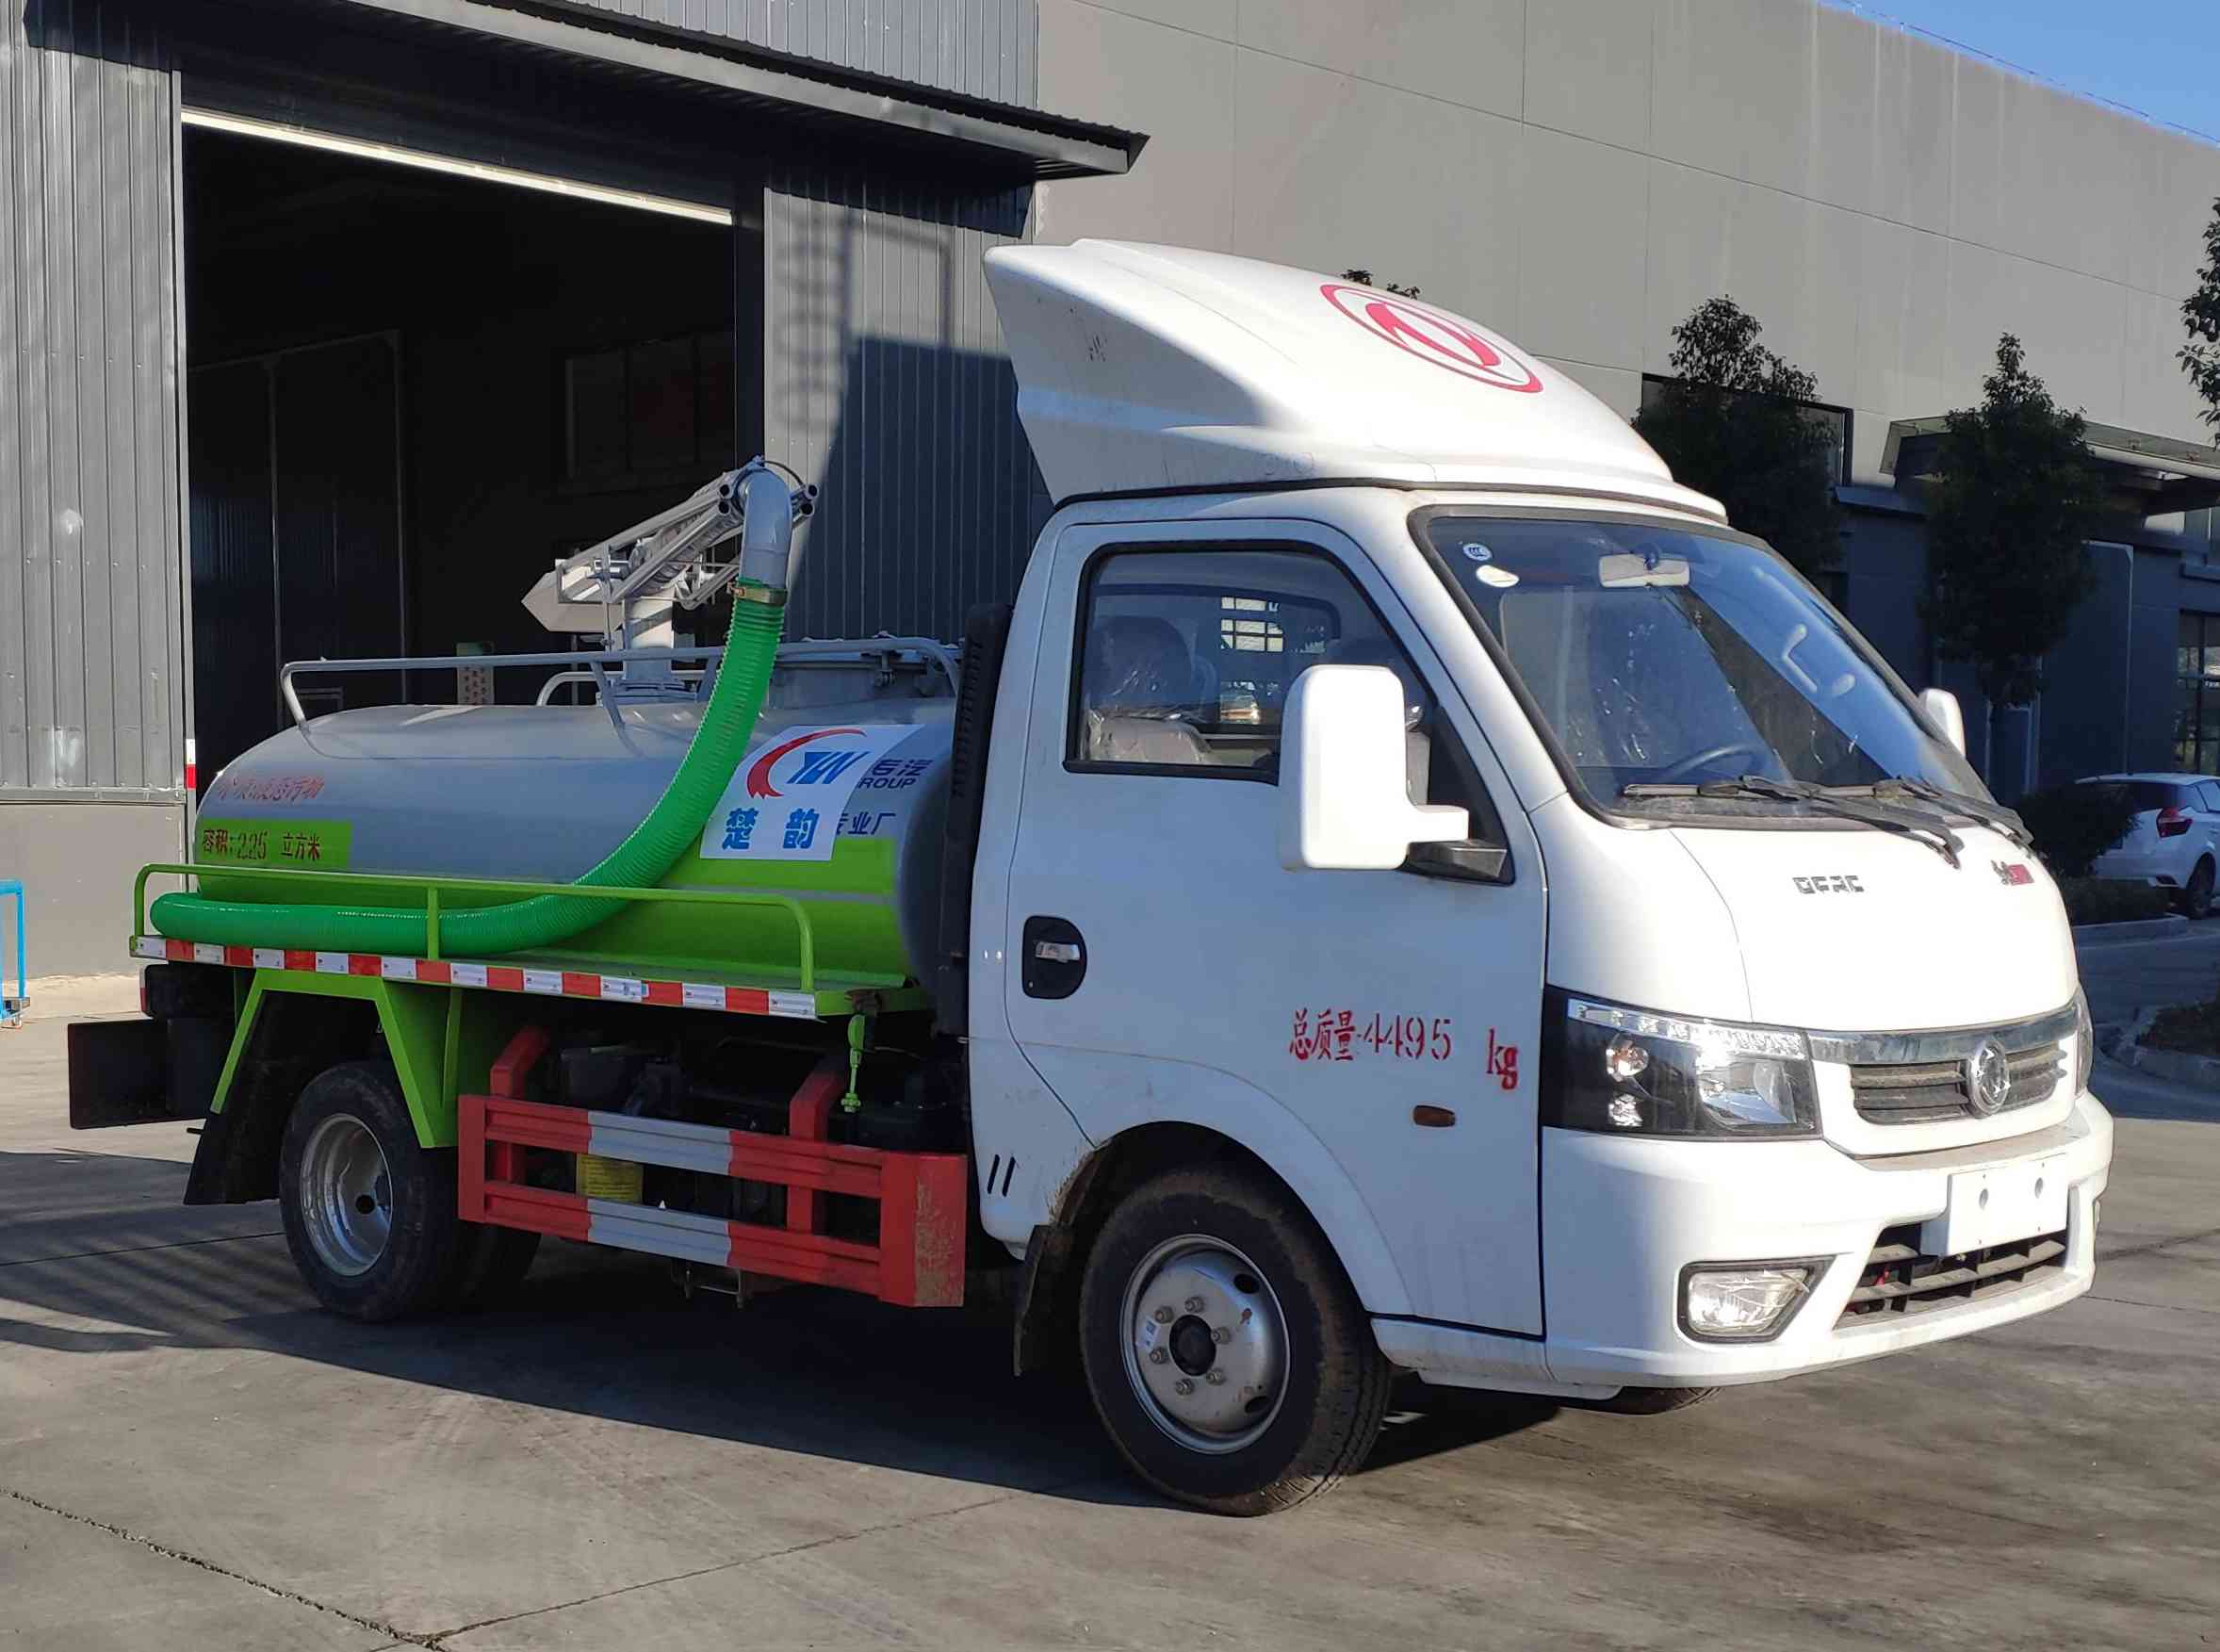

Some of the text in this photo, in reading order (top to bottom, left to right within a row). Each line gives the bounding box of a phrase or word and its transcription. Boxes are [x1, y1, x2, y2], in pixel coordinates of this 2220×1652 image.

[279, 831, 321, 861] 立方米
[1485, 1027, 1519, 1090] kg
